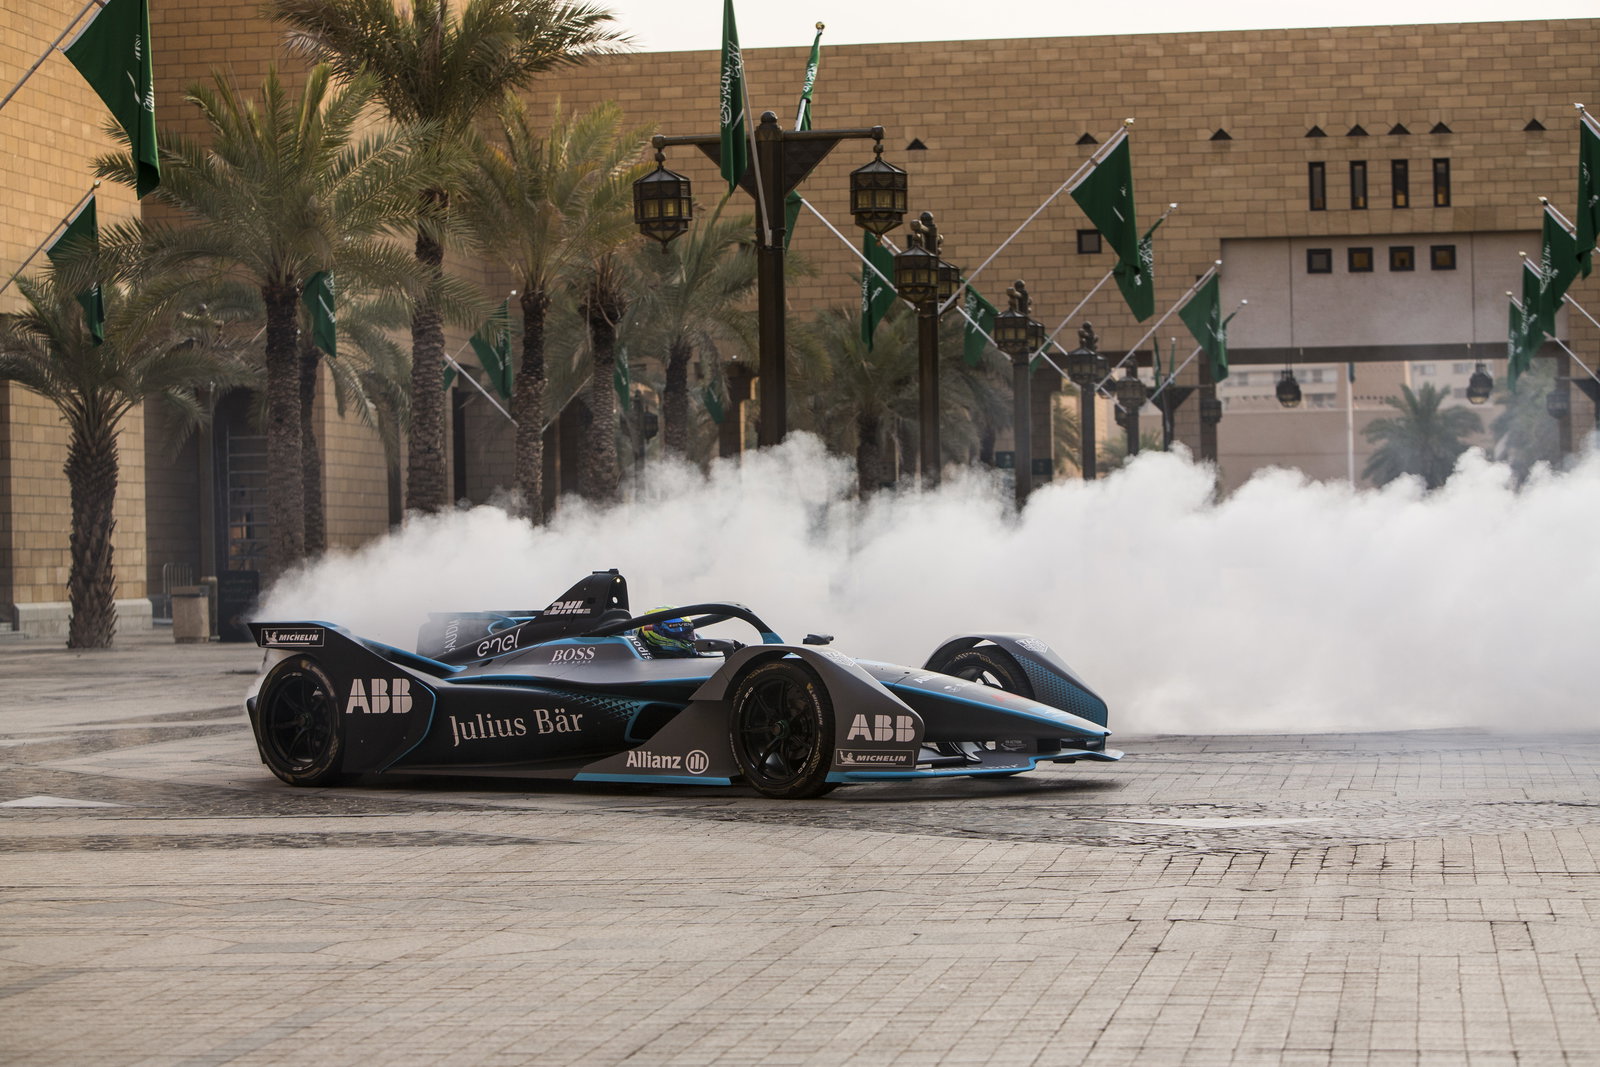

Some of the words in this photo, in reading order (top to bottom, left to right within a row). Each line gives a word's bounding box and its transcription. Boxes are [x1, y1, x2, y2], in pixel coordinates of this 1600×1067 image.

[549, 600, 586, 615] DHL
[278, 633, 319, 642] MICHELIN
[477, 628, 521, 657] enel
[550, 646, 596, 662] BOSS
[346, 678, 413, 714] ABB
[449, 713, 527, 747] Julius
[533, 708, 583, 735] Bär
[847, 714, 916, 742] ABB
[626, 750, 681, 769] Allianz
